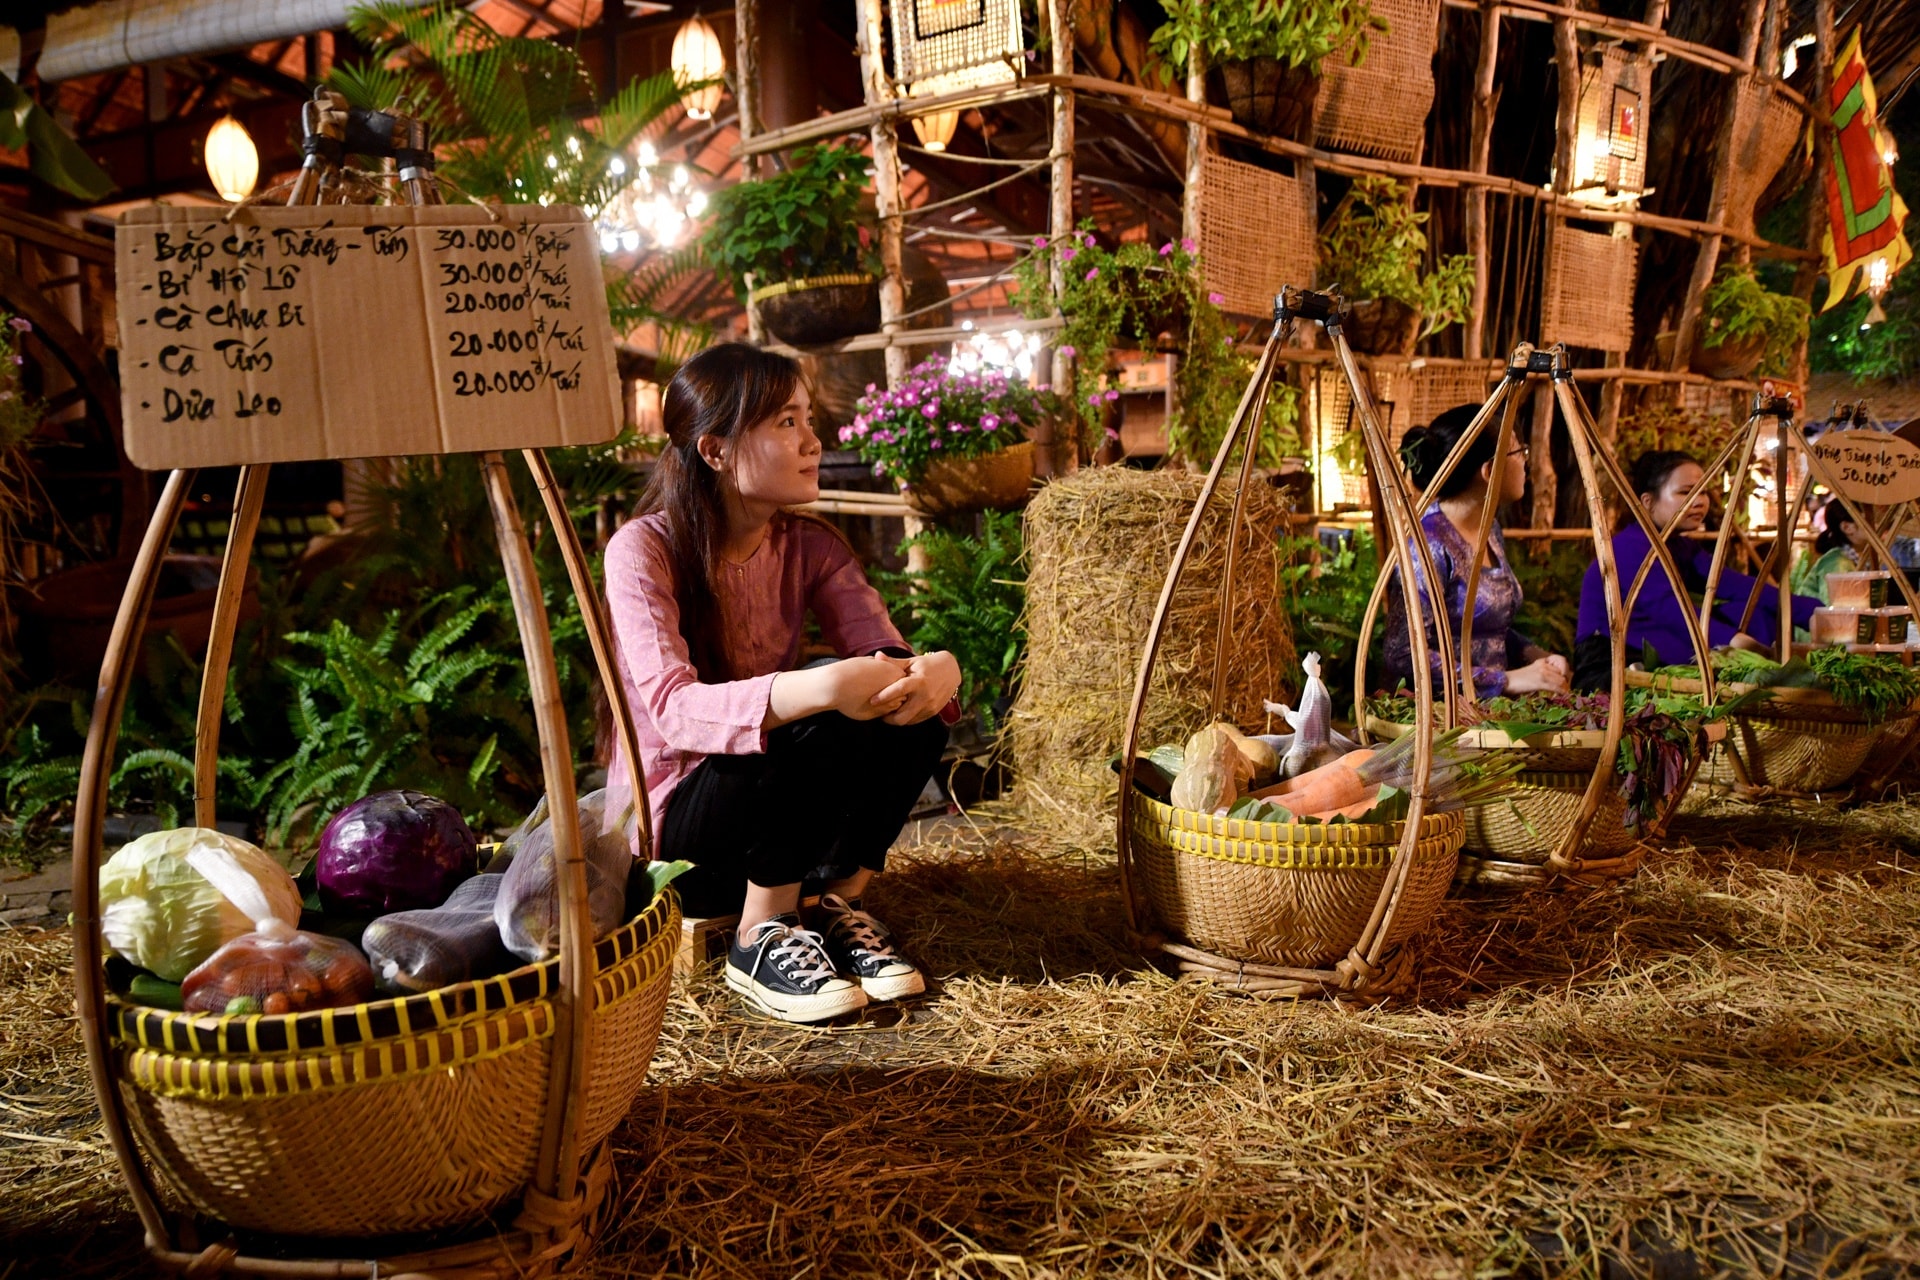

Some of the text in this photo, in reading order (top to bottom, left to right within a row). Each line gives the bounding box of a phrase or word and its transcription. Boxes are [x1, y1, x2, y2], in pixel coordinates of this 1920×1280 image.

[154, 219, 409, 272] Bắp Cải Trắng Tím
[158, 263, 301, 298] Bí Hồ Lô
[154, 299, 305, 331] Cà Chua Bi
[158, 337, 273, 377] Cà Tím
[235, 389, 281, 417] Leo
